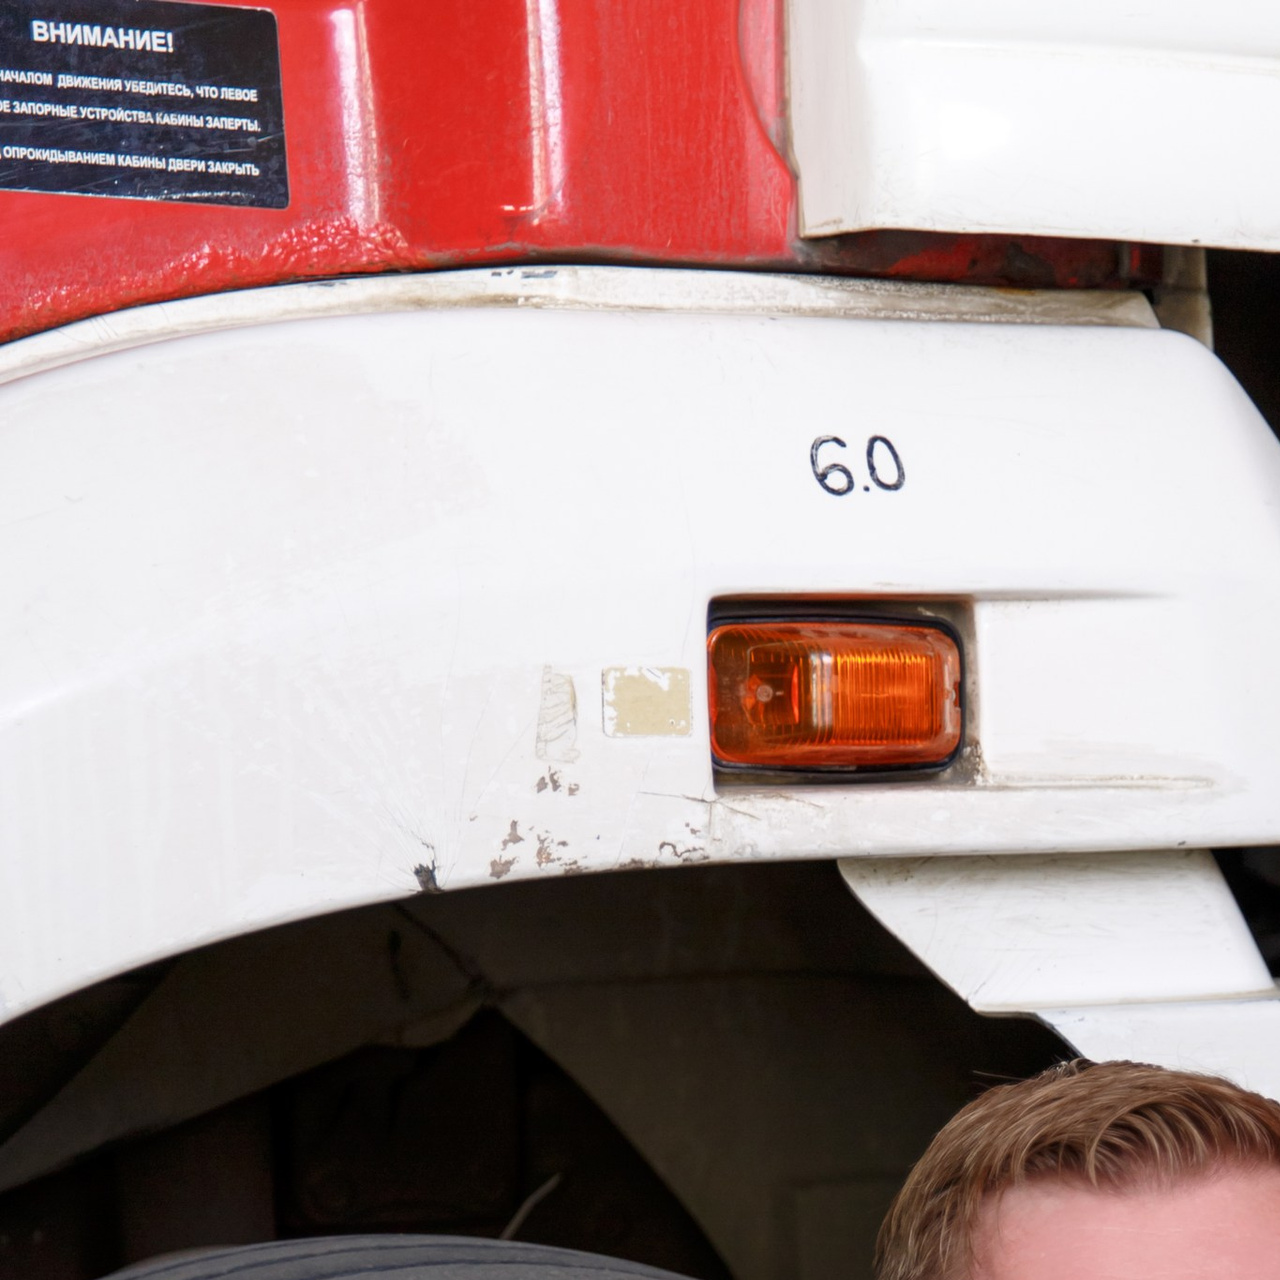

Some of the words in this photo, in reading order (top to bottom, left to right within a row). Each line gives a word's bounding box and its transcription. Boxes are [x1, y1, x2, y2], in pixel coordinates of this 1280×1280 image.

[31, 20, 174, 52] ВНИМАНИЕ!
[58, 73, 122, 91] ДВИЖЕНИЯ
[124, 79, 194, 99] УБЕДИТЕСЬ,
[195, 85, 219, 98] ЧТО
[220, 87, 258, 102] ЛЕВОЕ
[13, 101, 77, 118] ЗАПОРНЫЕ
[79, 105, 154, 124] УСТРОЙСТВА
[155, 112, 204, 128] КАБИНЫ
[205, 115, 261, 132] ЗАПЕРТЫ.
[3, 145, 116, 166] ОПРОКИДЫВАНИЕМ
[117, 153, 166, 170] КАБИНЫ
[168, 158, 206, 172] ДВЕРИ
[207, 160, 260, 176] ЗАКРЫТЬ
[810, 434, 906, 496] 6.0
